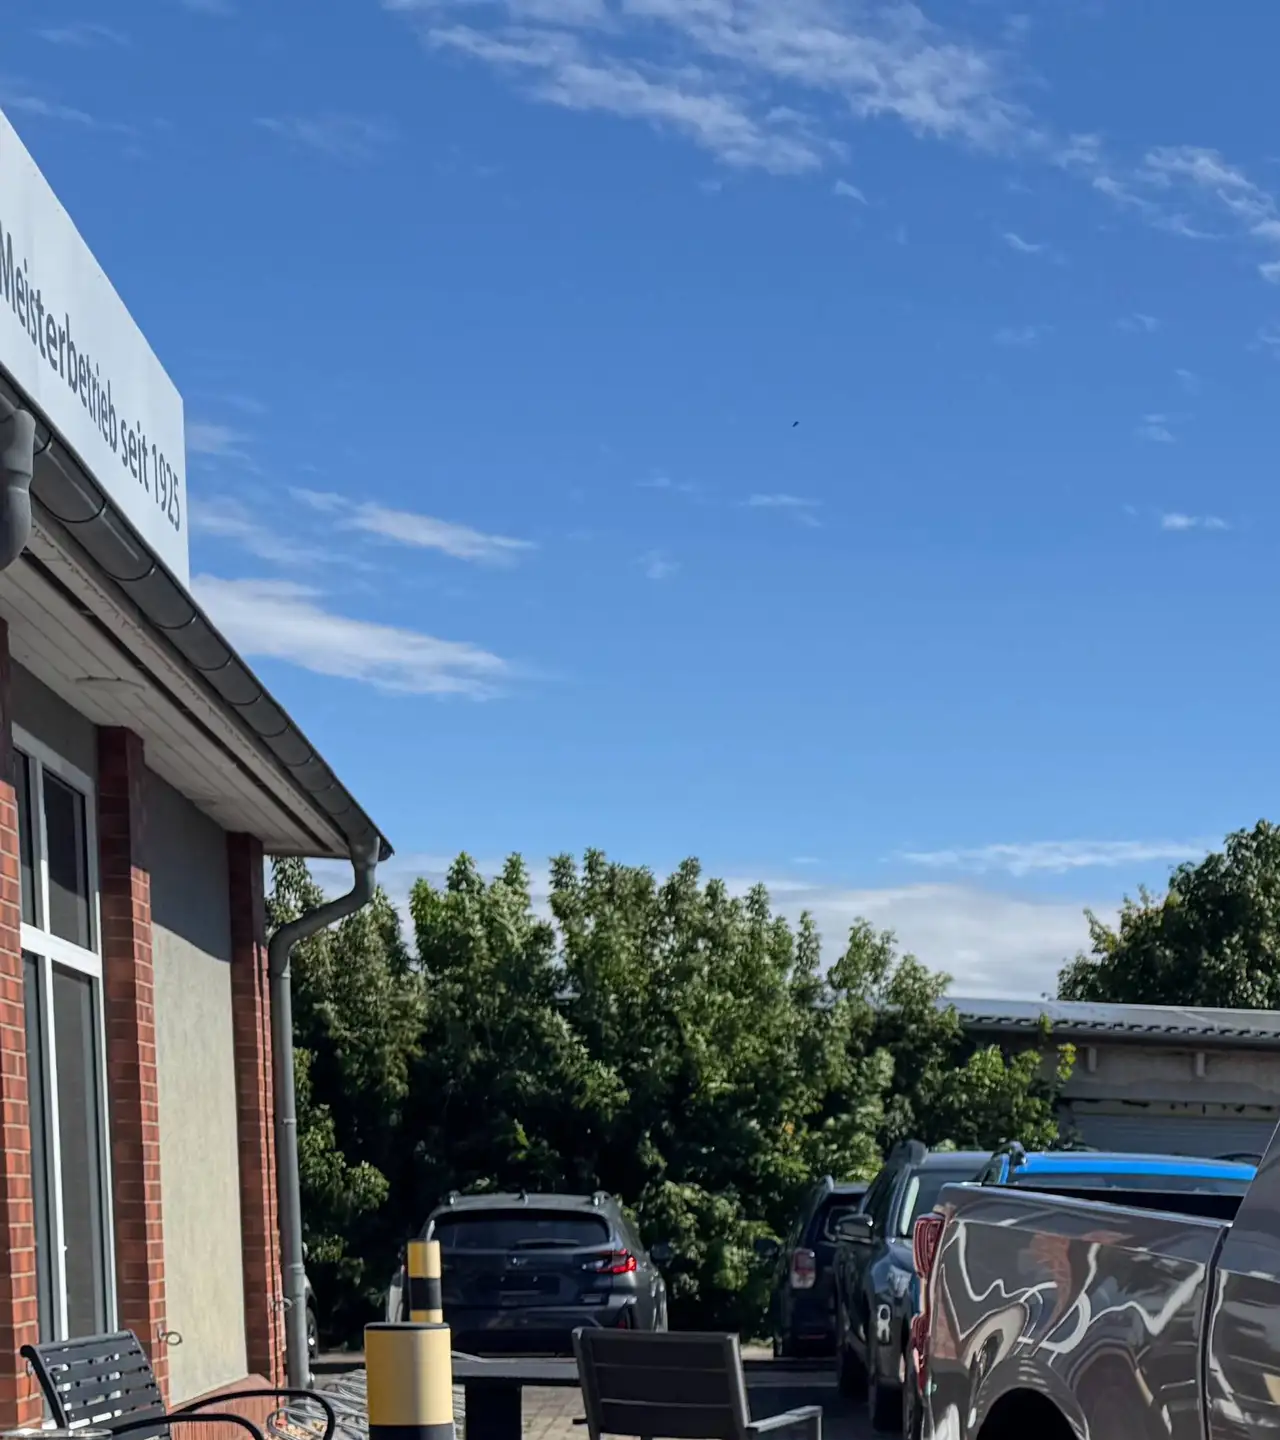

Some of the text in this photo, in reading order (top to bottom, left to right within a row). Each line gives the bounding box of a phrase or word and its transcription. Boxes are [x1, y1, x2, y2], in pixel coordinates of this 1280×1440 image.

[0, 219, 180, 532] Meisterbetrieb seit 1925
